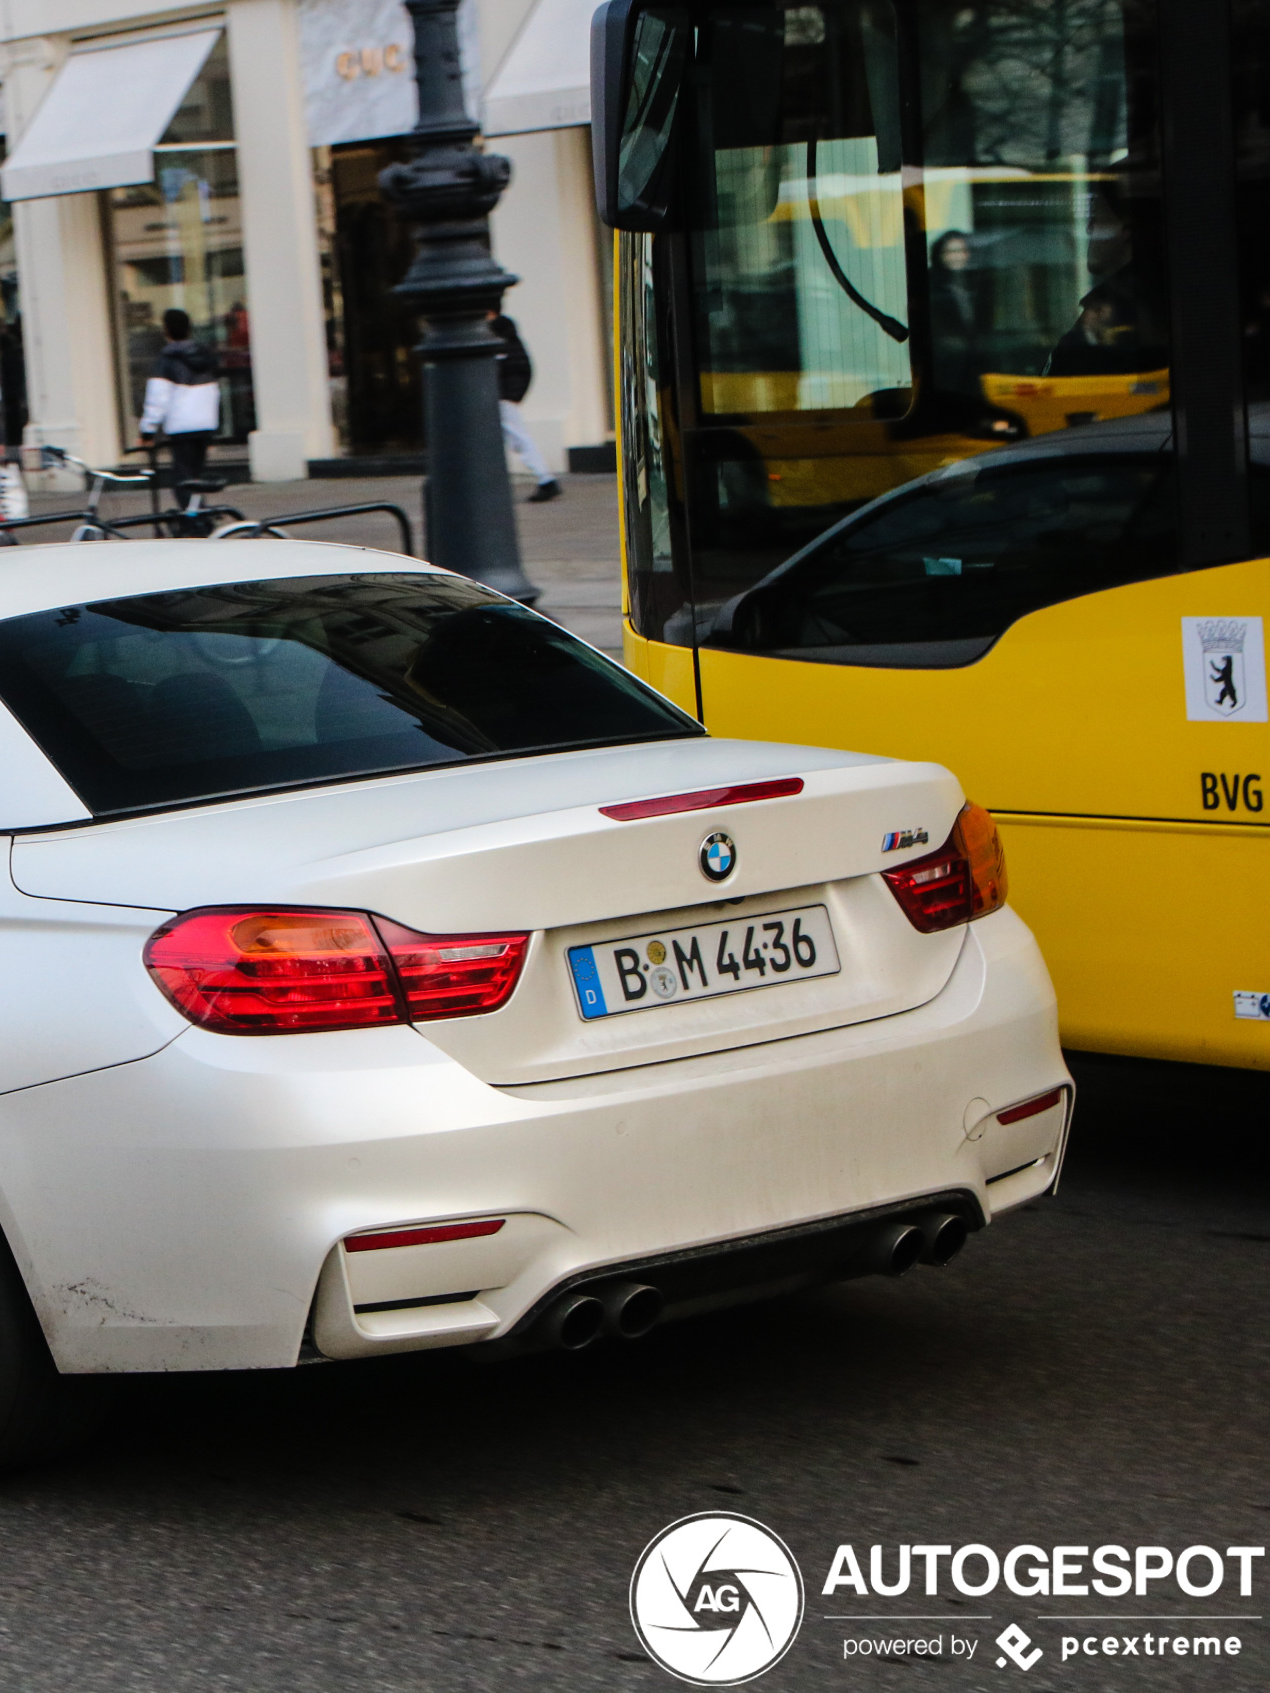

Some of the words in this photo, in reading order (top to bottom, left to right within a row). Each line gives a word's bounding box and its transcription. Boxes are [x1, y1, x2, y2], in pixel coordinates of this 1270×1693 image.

[336, 44, 406, 80] GUC
[1201, 772, 1263, 812] BVG
[716, 918, 817, 981] 4436
[585, 989, 597, 1005] D
